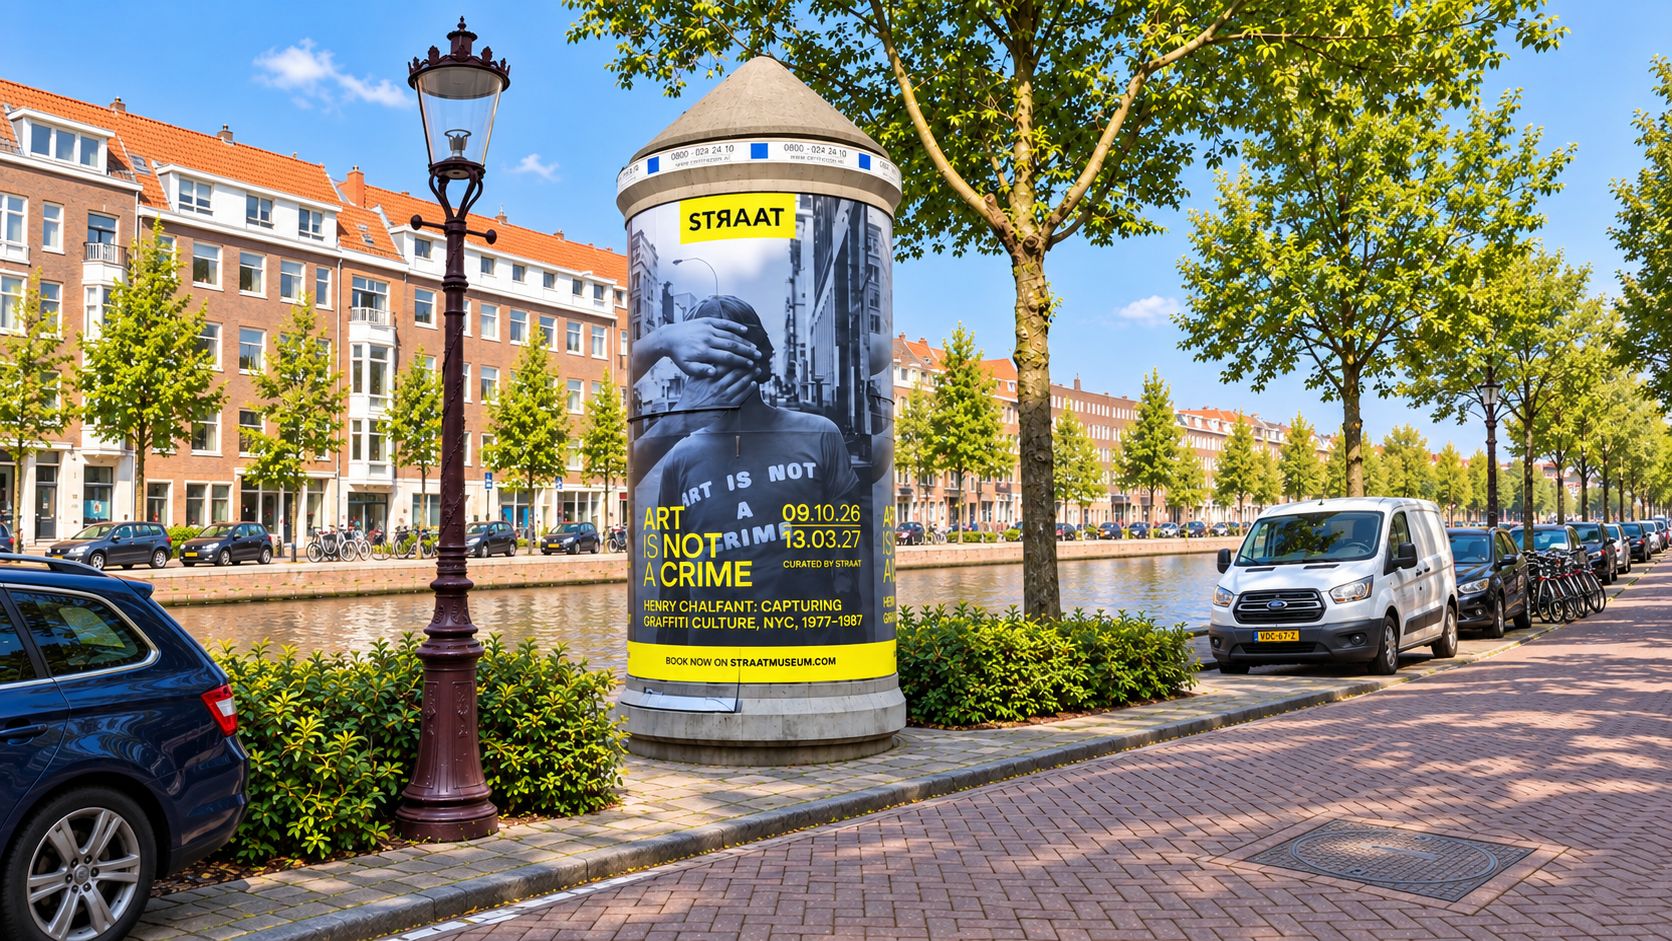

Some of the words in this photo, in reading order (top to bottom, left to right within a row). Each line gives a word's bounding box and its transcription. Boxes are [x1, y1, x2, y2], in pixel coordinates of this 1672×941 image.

[682, 480, 712, 508] ART
[726, 471, 752, 491] IS
[768, 462, 817, 482] NOT
[644, 505, 685, 530] ART
[737, 501, 754, 520] A
[782, 503, 860, 522] 09.10.26
[644, 533, 658, 558] IS
[664, 532, 722, 558] NOT
[783, 529, 860, 549] 13.03.27
[644, 561, 656, 587] A
[660, 560, 752, 587] CRIME
[783, 559, 822, 569] CURATED
[824, 559, 834, 568] BY
[836, 559, 861, 568] STRAAT
[644, 600, 676, 613] HENRY
[679, 600, 758, 613] CHALFANT:
[761, 599, 842, 613] CAPTURING
[644, 616, 688, 628] GRAFFITI
[692, 616, 760, 631] CULTURE,
[764, 617, 799, 631] NYC,
[665, 656, 688, 666] BOOK
[690, 657, 712, 667] NOW
[713, 658, 728, 667] ON
[730, 656, 836, 667] STRAATMUSEUM.COM
